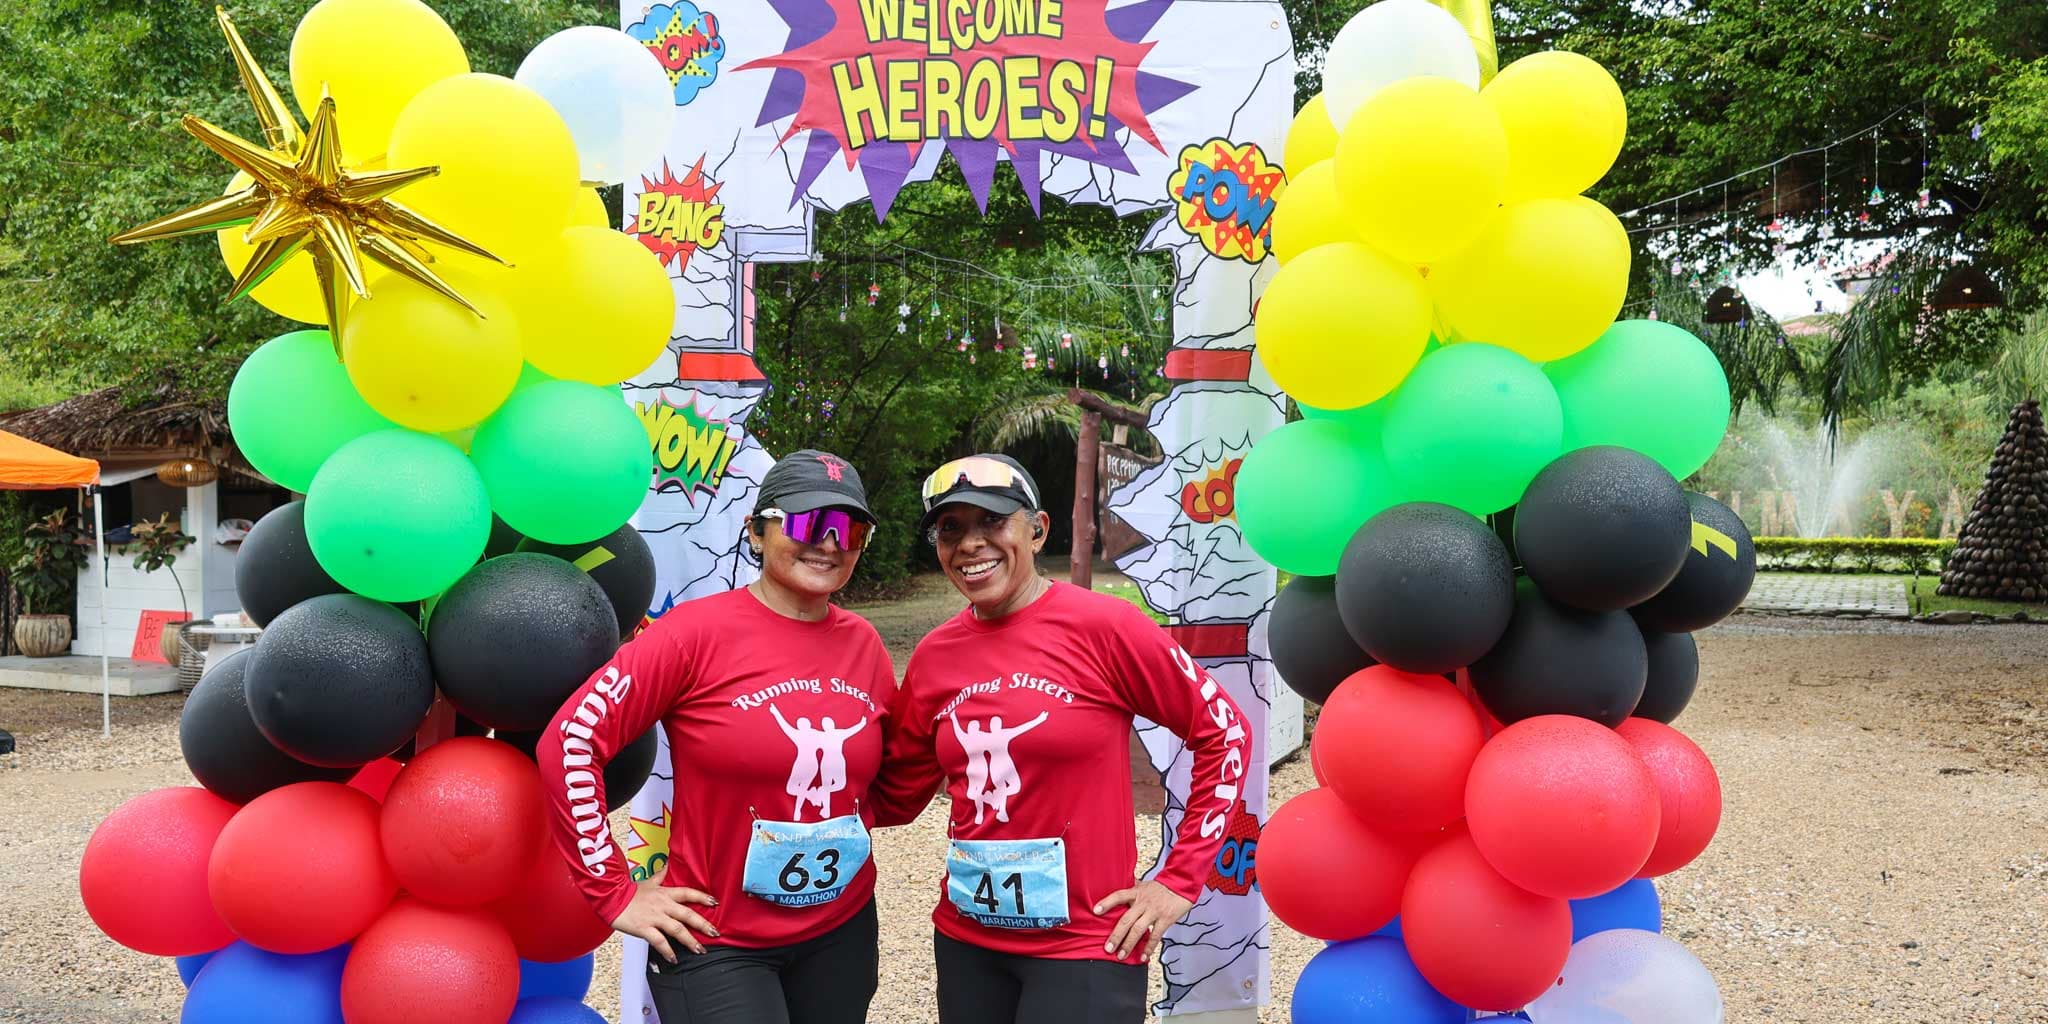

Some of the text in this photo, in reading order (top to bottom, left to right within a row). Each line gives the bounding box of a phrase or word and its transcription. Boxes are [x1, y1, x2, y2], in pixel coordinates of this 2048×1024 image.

[859, 0, 1062, 55] WELCOME
[830, 52, 1116, 150] HEROES!
[638, 190, 725, 250] BANG
[731, 677, 823, 711] Running
[1008, 672, 1075, 704] Sisters
[1169, 644, 1247, 841] Sisters
[560, 664, 632, 877] Running
[778, 847, 840, 893] 63
[778, 889, 838, 905] MARATHON
[973, 872, 1025, 915] 41
[979, 914, 1034, 928] MARATHON
